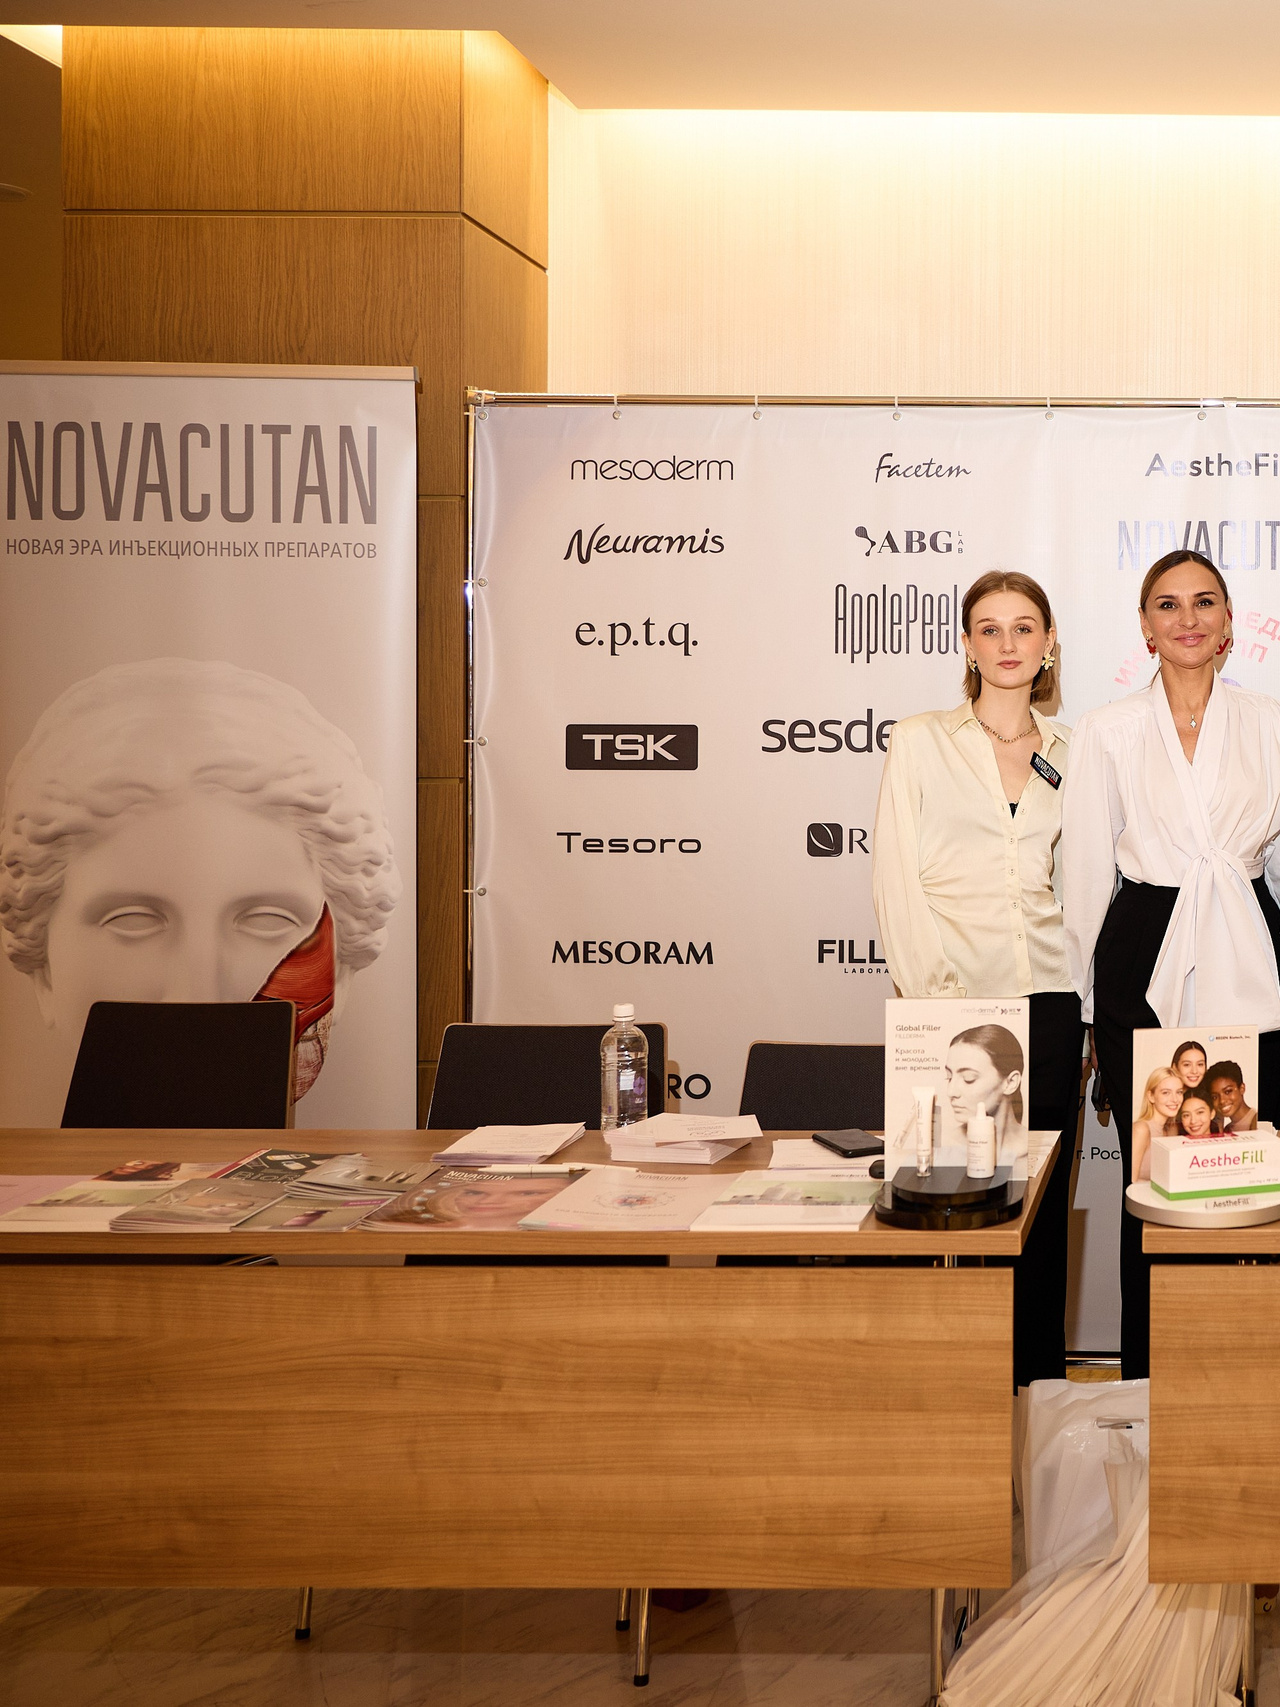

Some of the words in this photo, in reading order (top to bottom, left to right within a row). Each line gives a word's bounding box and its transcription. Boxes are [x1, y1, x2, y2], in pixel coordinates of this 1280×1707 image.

[7, 421, 378, 525] NOVACUTAN
[571, 454, 734, 481] mesoderm
[875, 452, 971, 483] Facetem
[6, 539, 64, 556] НОВАЯ
[69, 540, 103, 556] ЭРА
[109, 540, 259, 559] ИНЪЕКЦИОННЫХ
[264, 542, 378, 559] ПРЕПАРАТОВ
[563, 523, 726, 564] Neuramis
[876, 529, 954, 555] ABG
[834, 583, 959, 663] ApplePeel
[575, 617, 700, 656] e.p.t.q.
[582, 733, 679, 761] TSK
[556, 831, 702, 854] Tesoro
[552, 940, 714, 966] MESORAM
[1189, 1149, 1264, 1169] AestheFill
[446, 1170, 514, 1180] NOVACUTAN
[1213, 1198, 1250, 1208] AestheFill
